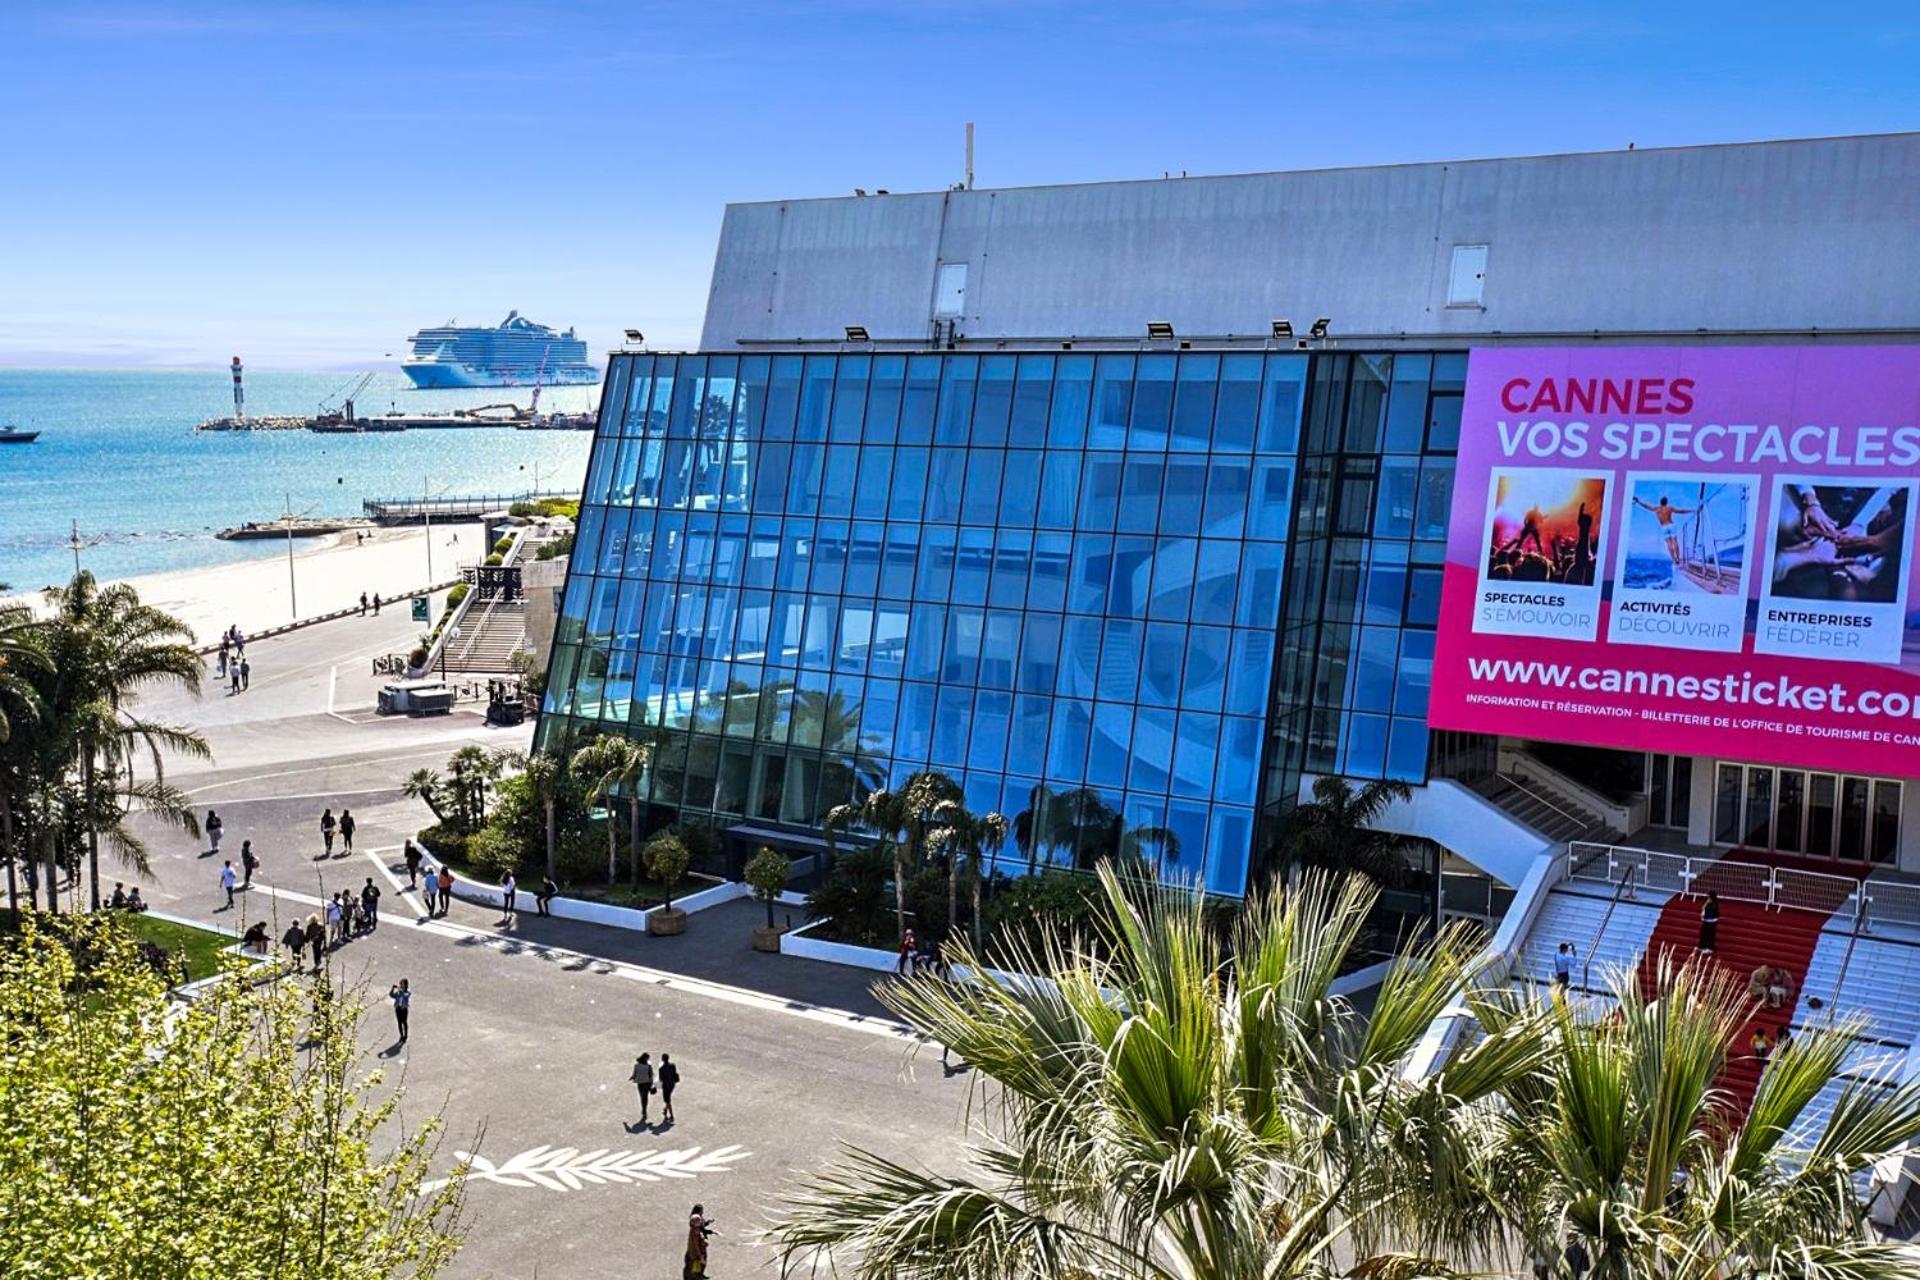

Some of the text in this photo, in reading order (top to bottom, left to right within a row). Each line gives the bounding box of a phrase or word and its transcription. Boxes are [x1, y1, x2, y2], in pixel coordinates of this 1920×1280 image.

[1501, 377, 1696, 416] CANNES
[1497, 421, 1920, 467] VOS SPECTACLES
[1484, 592, 1566, 607] SPECTACLES
[1619, 601, 1691, 616] ACTIVITÉS
[1481, 604, 1592, 629] S'ÉMOUVOIR
[1619, 614, 1731, 639] DÉCOUVRIR
[1767, 609, 1873, 628] ENTREPRISES
[1766, 623, 1861, 648] FÉDÉRER
[1468, 657, 1920, 720] www.cannesticket.co
[1466, 694, 1540, 709] INFORMATION
[1541, 701, 1554, 710] ET
[1556, 701, 1633, 717] RÉSERVATION
[1641, 709, 1711, 726] BILLETTERIE
[1713, 717, 1730, 728] DE
[1732, 718, 1783, 733] L'OFFICE
[1786, 724, 1804, 735] DE
[1806, 726, 1871, 741] TOURISME
[1873, 732, 1891, 742] DE
